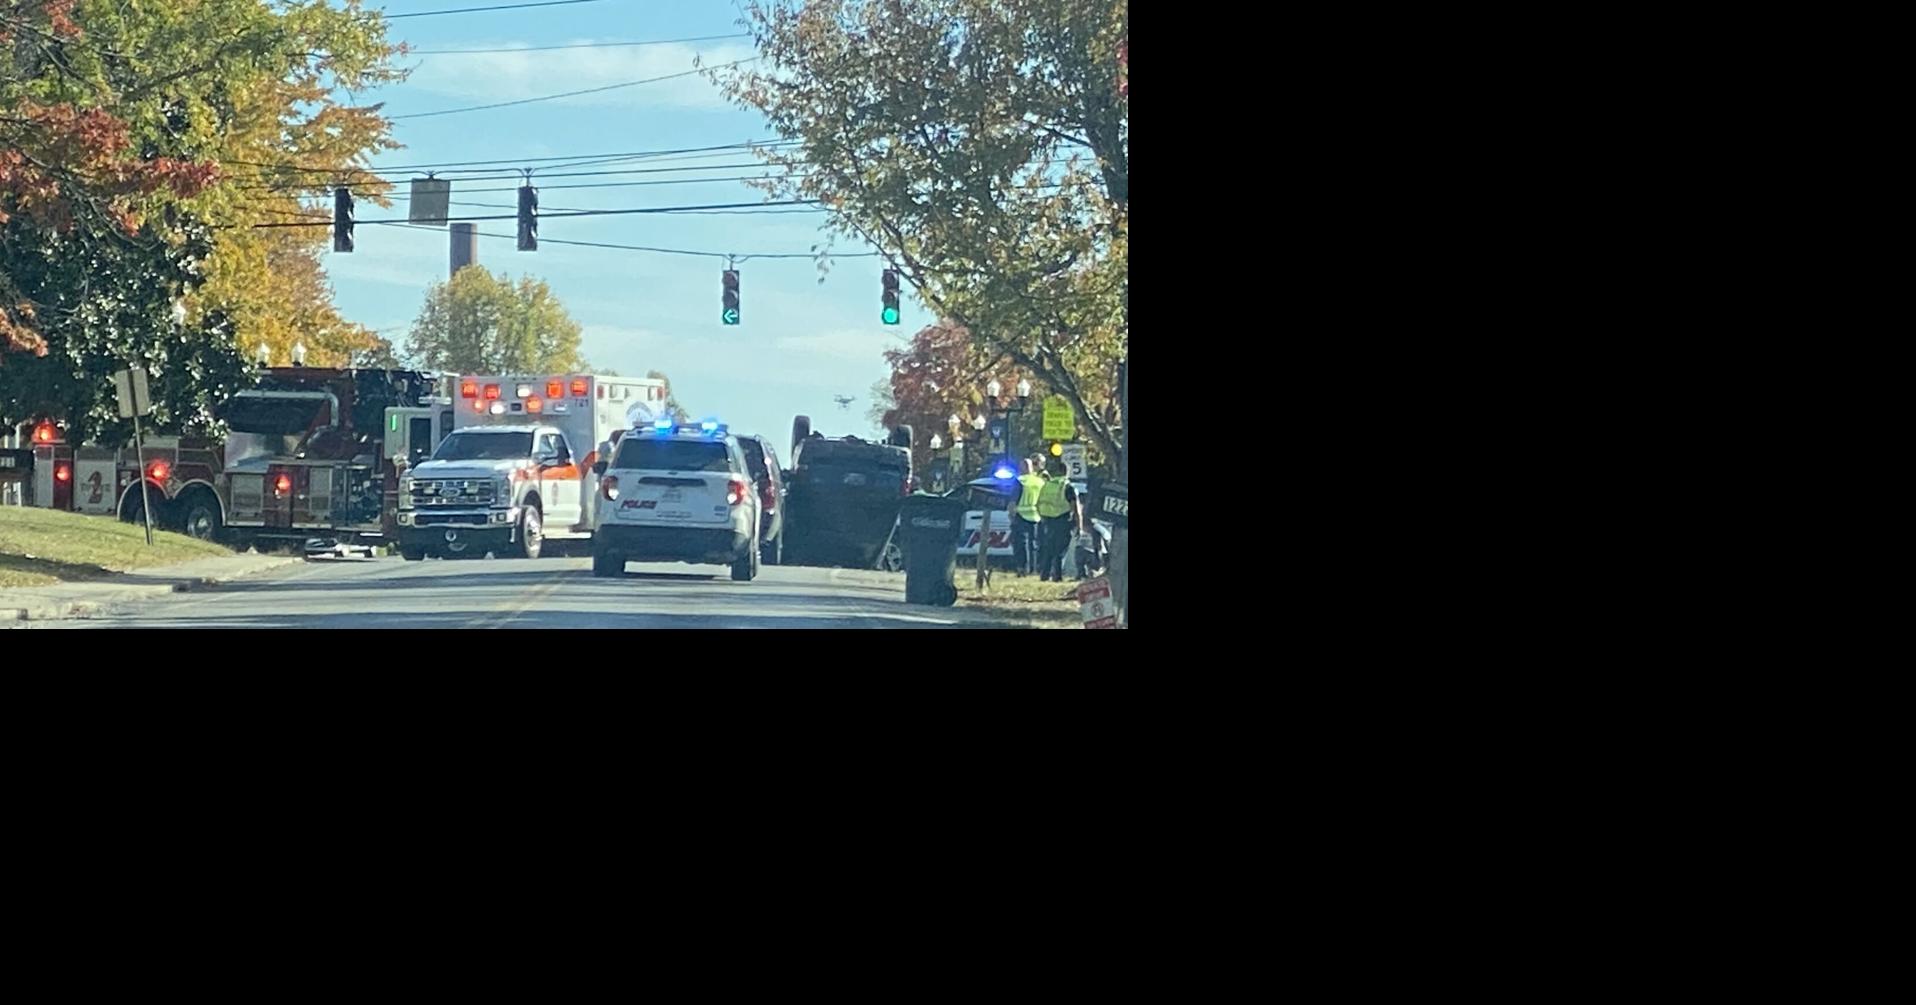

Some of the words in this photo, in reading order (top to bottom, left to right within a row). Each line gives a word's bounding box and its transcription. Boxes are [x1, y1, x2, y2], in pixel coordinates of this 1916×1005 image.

[88, 471, 102, 504] 2
[621, 500, 658, 509] POLICE
[1106, 498, 1127, 513] 122
